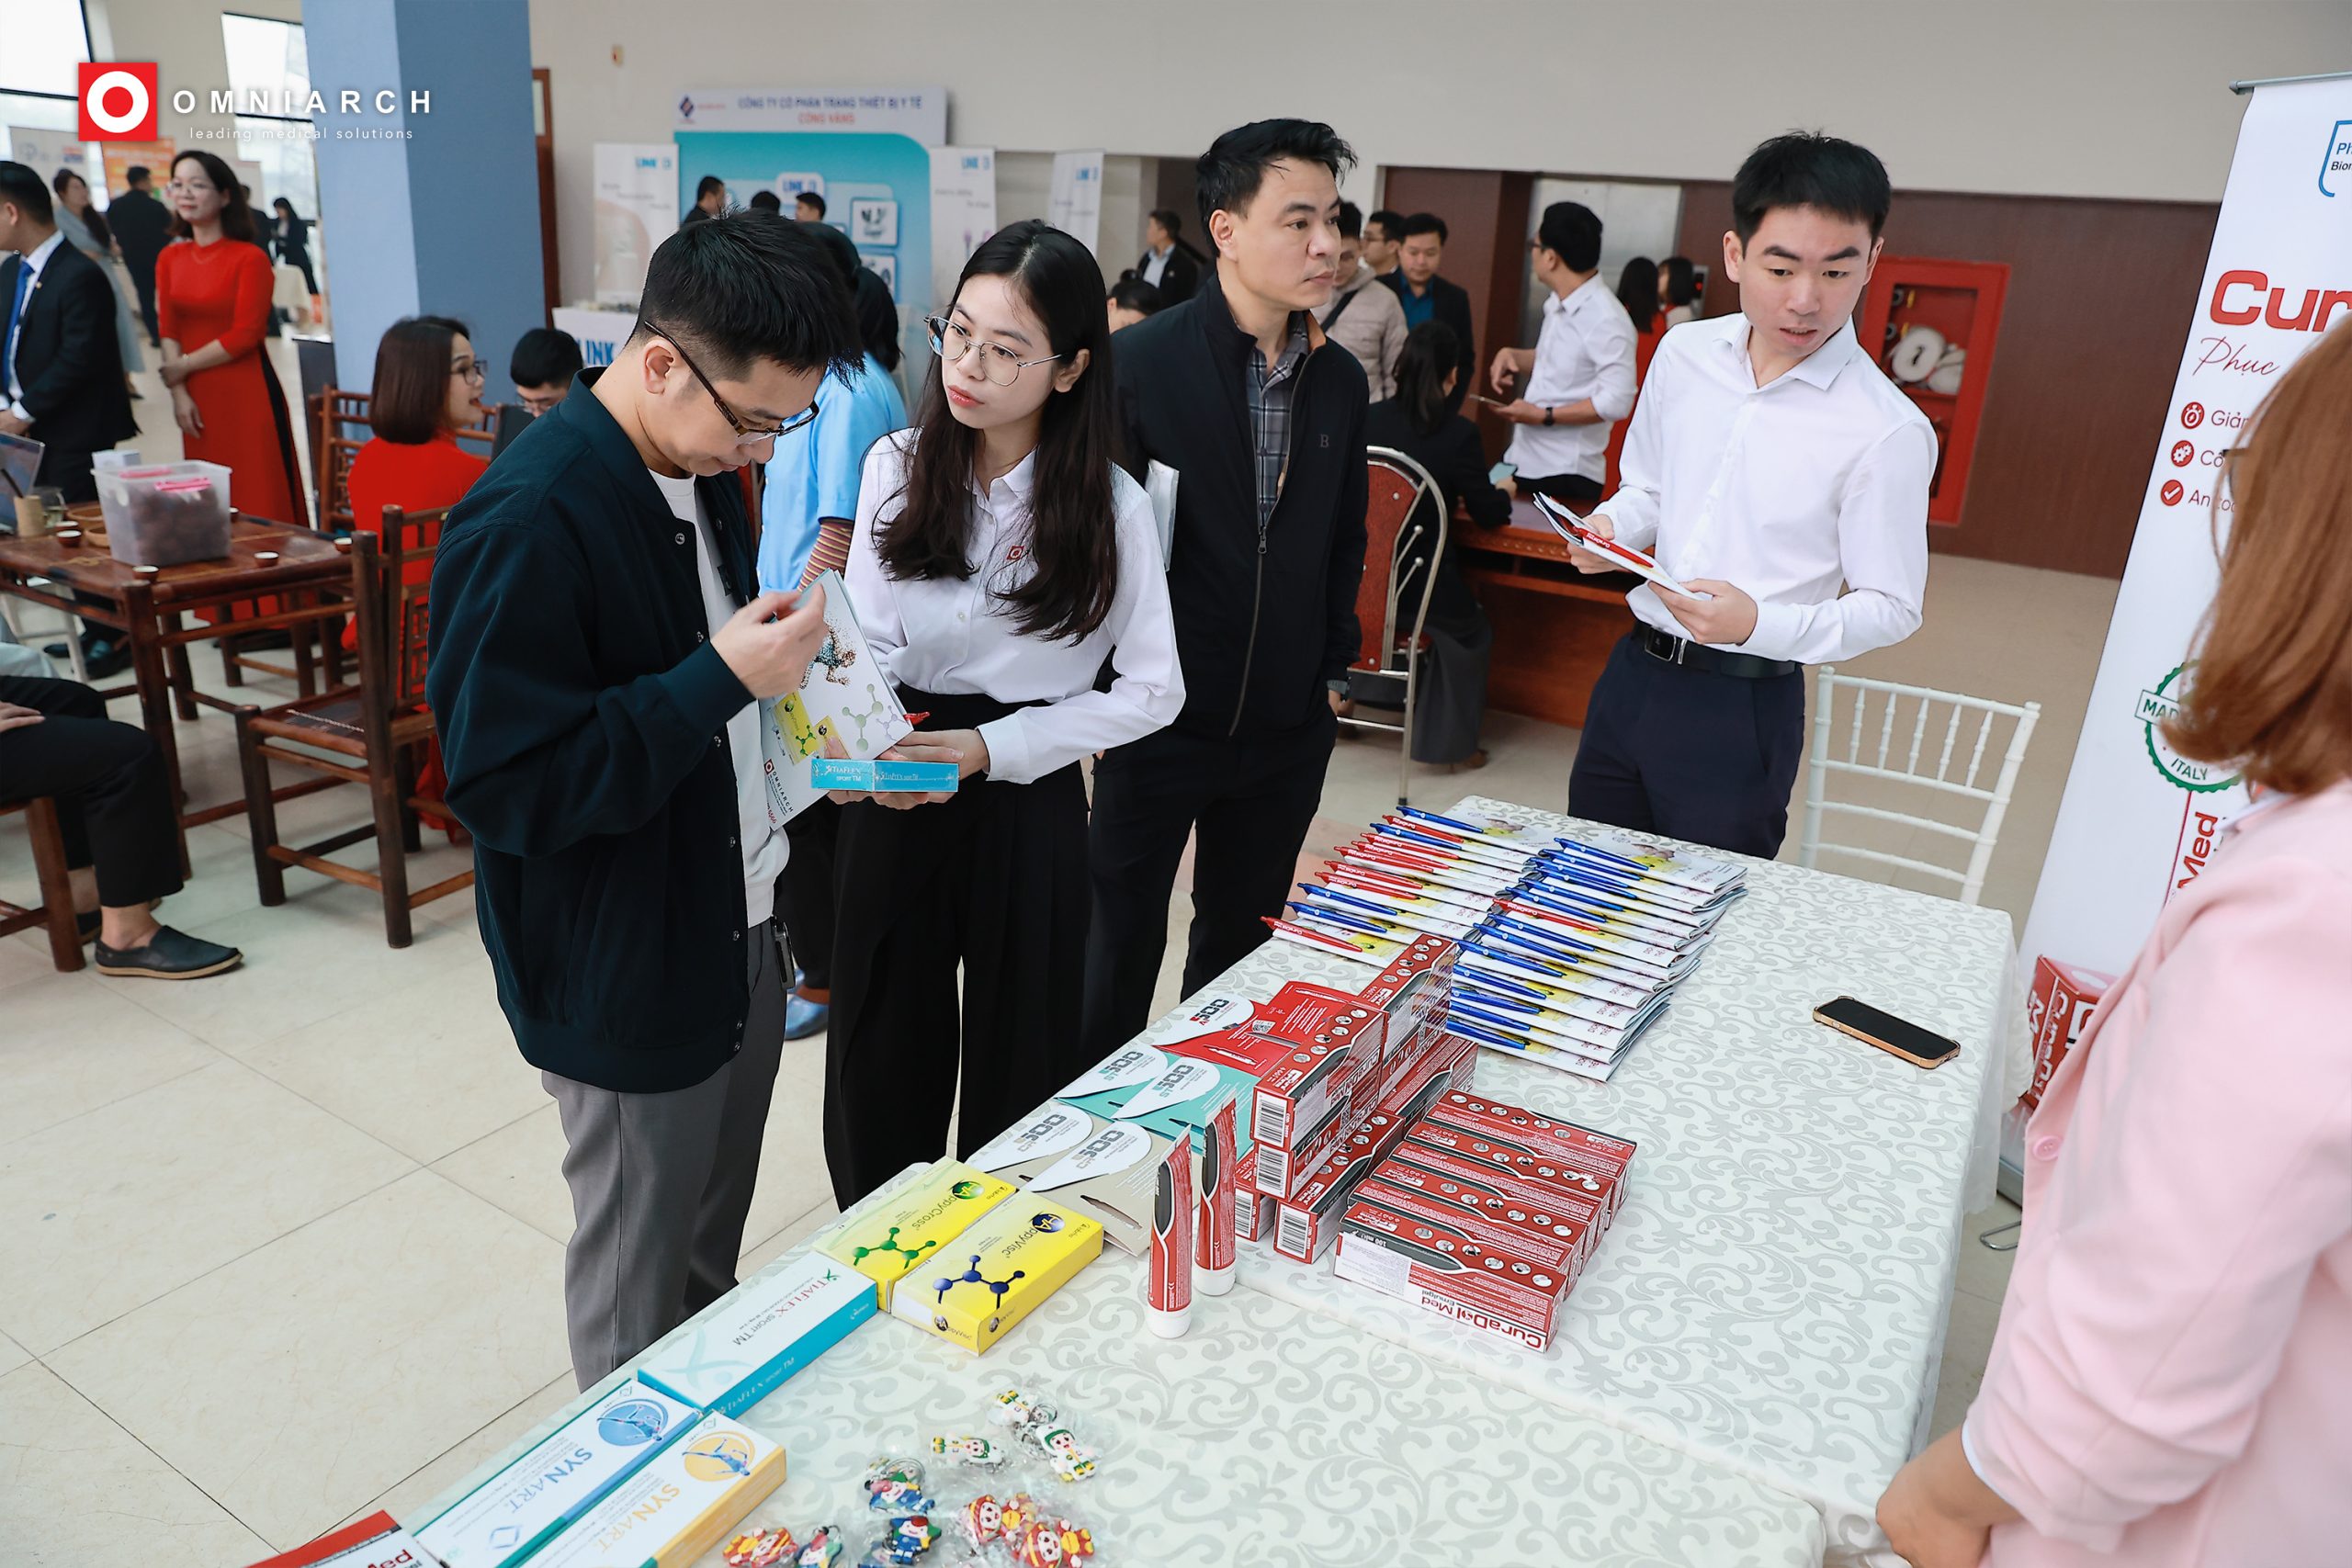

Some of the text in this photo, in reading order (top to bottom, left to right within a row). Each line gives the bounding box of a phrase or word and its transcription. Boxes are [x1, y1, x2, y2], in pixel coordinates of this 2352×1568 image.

[578, 338, 615, 366] INK
[2171, 758, 2208, 780] ITALY
[1421, 1296, 1453, 1314] Med
[1422, 1291, 1454, 1306] Emulgel
[731, 1331, 754, 1347] TM
[506, 1447, 593, 1515] SYNART
